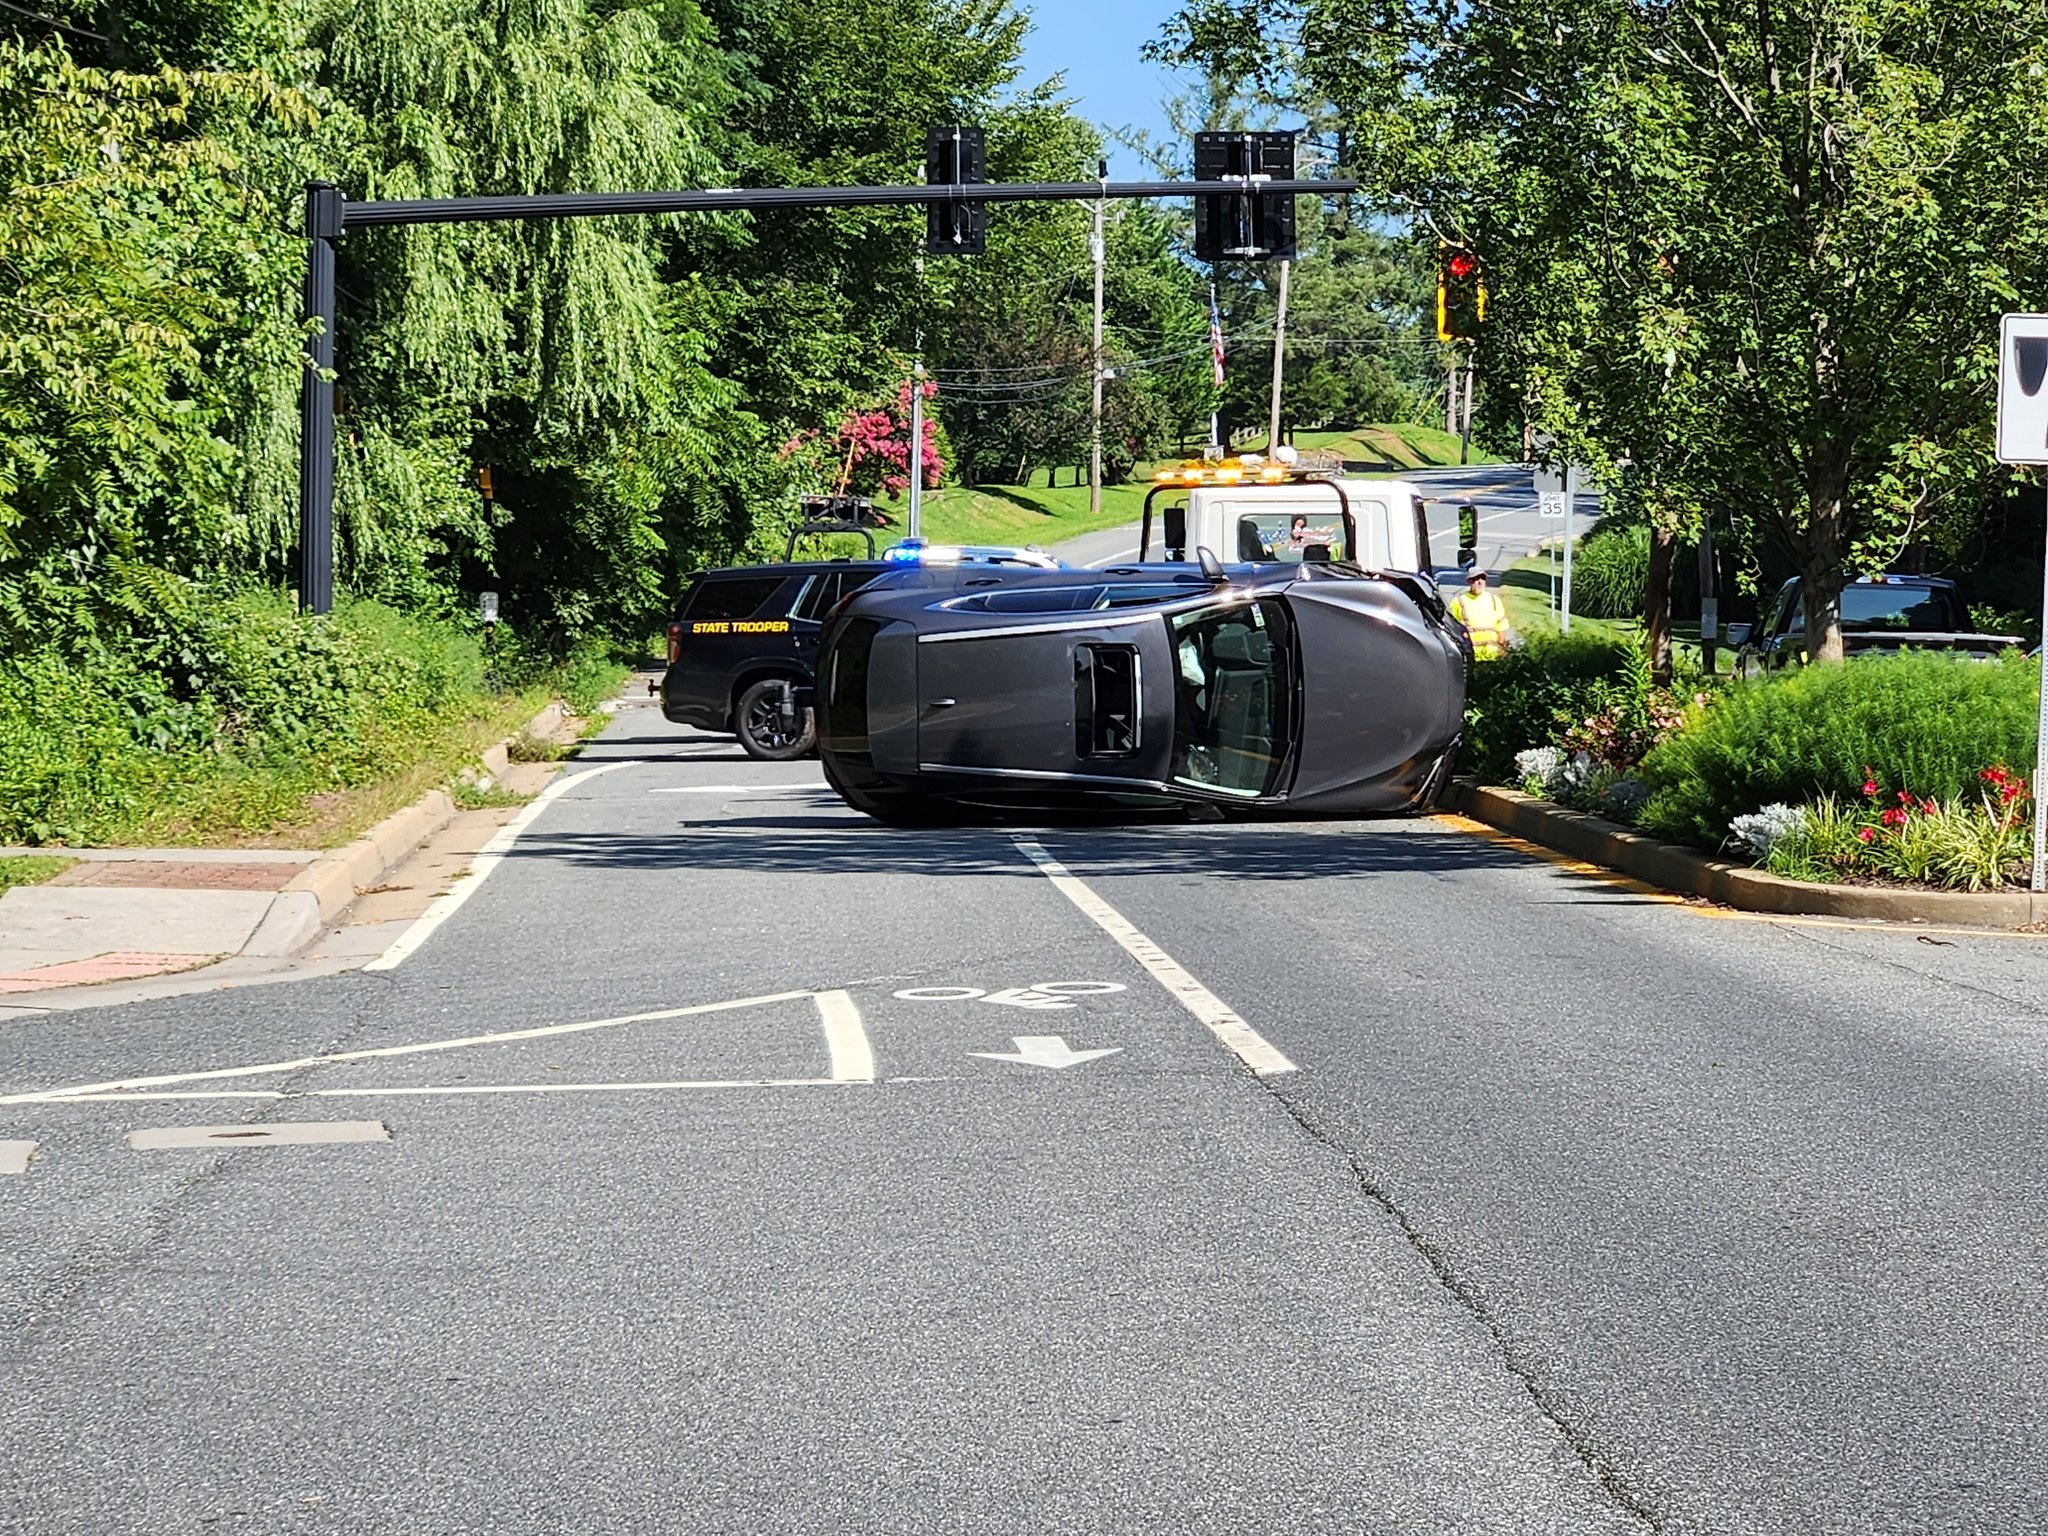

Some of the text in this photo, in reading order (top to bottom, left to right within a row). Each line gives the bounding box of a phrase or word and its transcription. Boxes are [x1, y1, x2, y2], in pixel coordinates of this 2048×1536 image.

[1543, 502, 1562, 515] 35
[692, 621, 789, 633] STATE TROOPER
